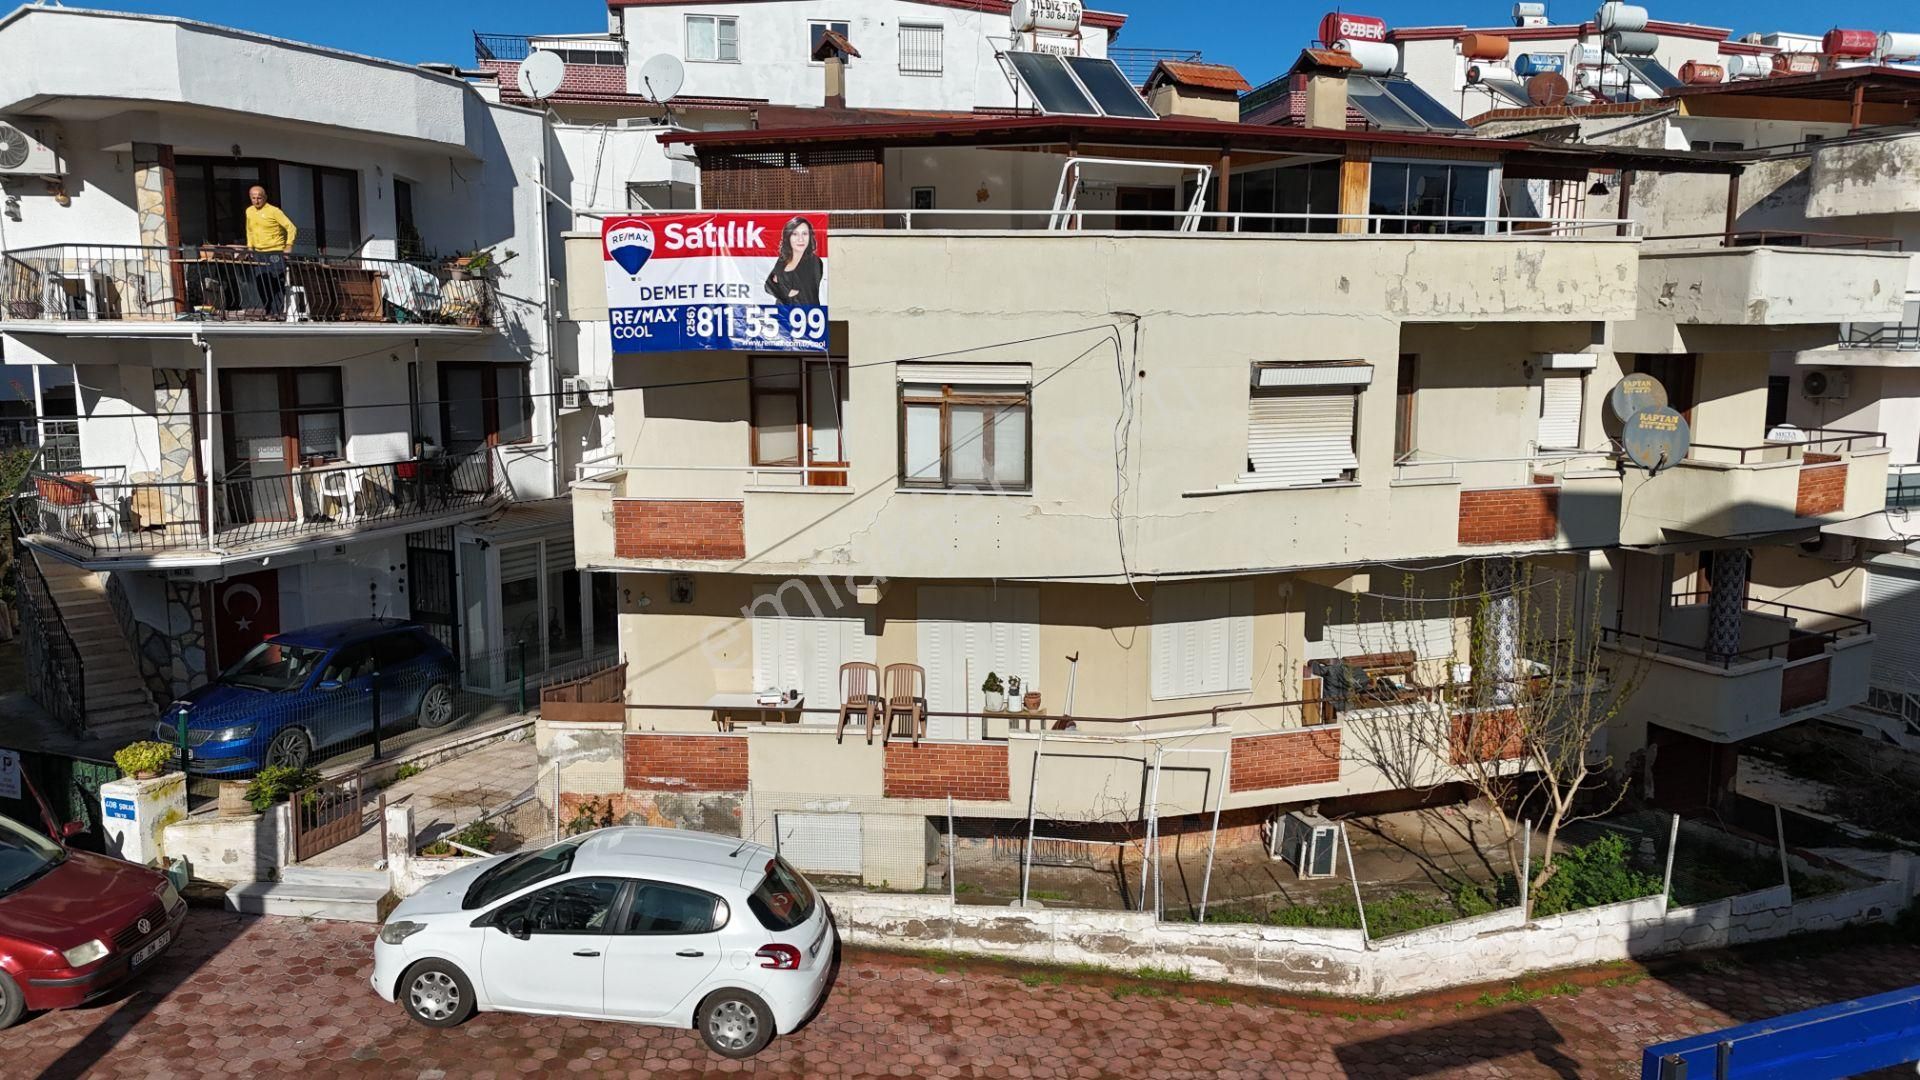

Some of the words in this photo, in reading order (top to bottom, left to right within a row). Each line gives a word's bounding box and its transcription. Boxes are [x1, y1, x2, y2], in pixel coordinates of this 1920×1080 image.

[1046, 11, 1055, 19] 30
[1057, 12, 1066, 20] 64
[1340, 18, 1385, 40] ÖZBEK
[612, 231, 649, 244] RE/MAX
[664, 220, 766, 249] Satılık
[640, 284, 698, 301] DEMET
[703, 283, 751, 299] EKER
[611, 308, 677, 325] RE/MAX
[686, 306, 697, 337] (256)
[697, 306, 734, 337] 811
[745, 307, 779, 339] 55
[788, 307, 826, 340] 99
[614, 326, 653, 339] COOL
[1639, 412, 1679, 424] KAPTAN
